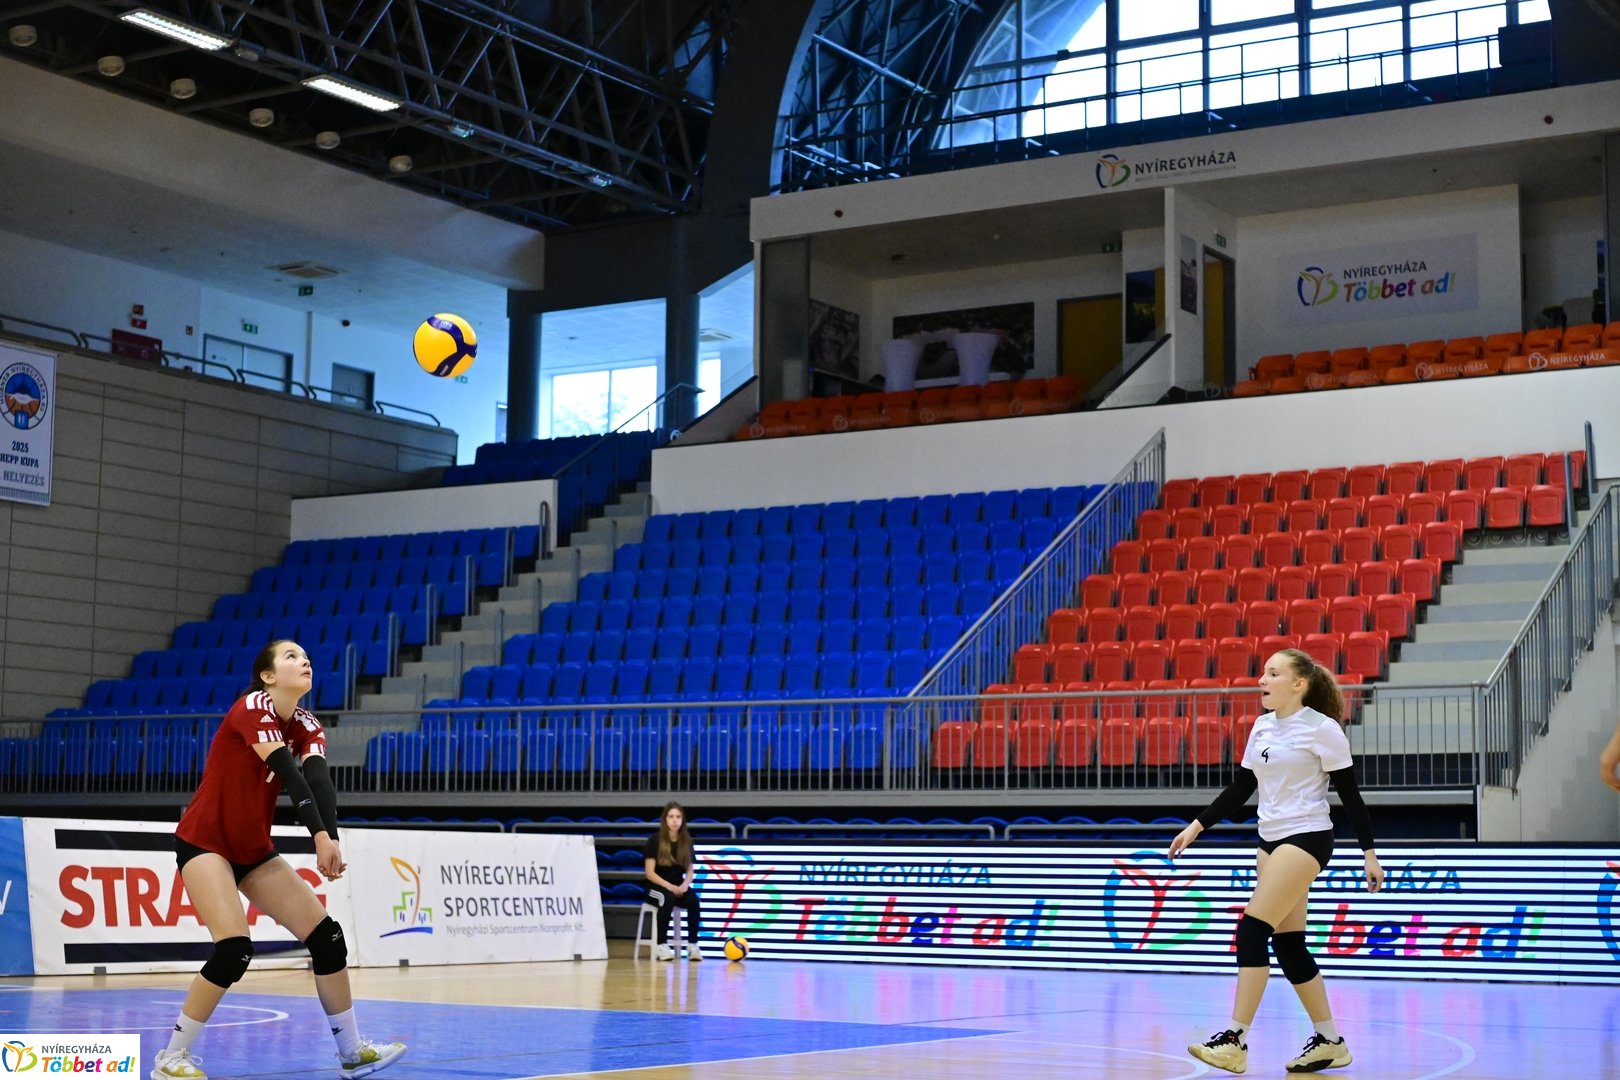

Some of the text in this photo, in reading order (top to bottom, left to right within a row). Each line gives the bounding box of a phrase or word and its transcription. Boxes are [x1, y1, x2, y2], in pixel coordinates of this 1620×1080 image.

[1135, 150, 1236, 175] NYÍREGYHÁZA
[1343, 259, 1427, 280] NYÍREGYHÁZA
[1343, 271, 1456, 303] Többet ad!
[1549, 352, 1606, 365] NYÍREGYHÁZA
[12, 440, 29, 453] 2025
[20, 456, 39, 468] KUPA
[3, 470, 45, 487] HELYEZÉS
[1262, 747, 1270, 763] 4
[440, 860, 555, 886] NYÍREGYHÁZI
[799, 858, 992, 888] NYÍREGYHÁZA
[443, 896, 584, 918] SPORTCENTRUM
[490, 924, 538, 936] Sportcentrum
[795, 895, 1061, 947] Többet ad!
[1441, 904, 1546, 959] ad!
